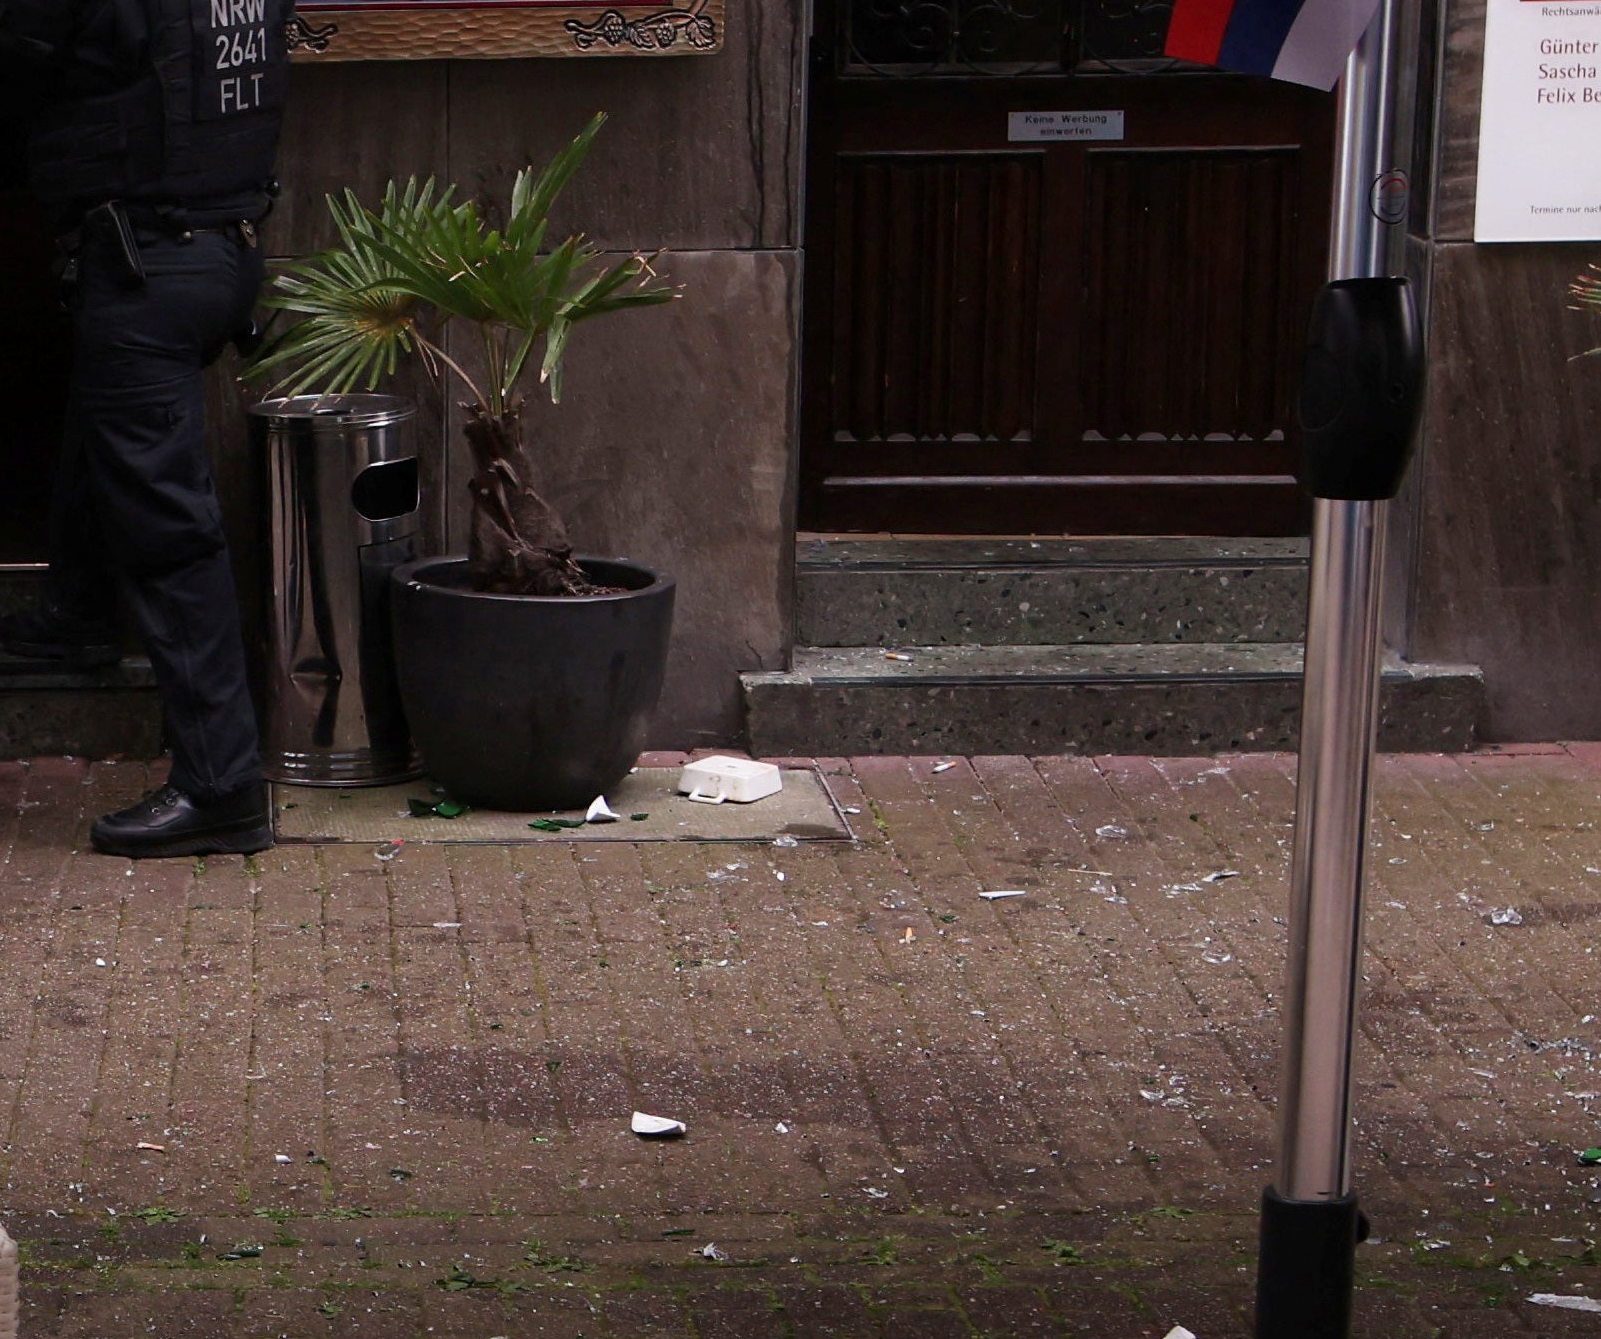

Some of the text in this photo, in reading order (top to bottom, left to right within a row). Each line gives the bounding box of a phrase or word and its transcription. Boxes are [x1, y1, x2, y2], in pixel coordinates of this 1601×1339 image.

[215, 28, 267, 70] 2641
[1540, 38, 1598, 54] Günter
[1538, 64, 1596, 79] Sascha
[220, 73, 264, 114] FLT
[1537, 88, 1576, 104] Felix
[1025, 114, 1107, 124] Keine Werbung
[1530, 205, 1564, 214] Termine
